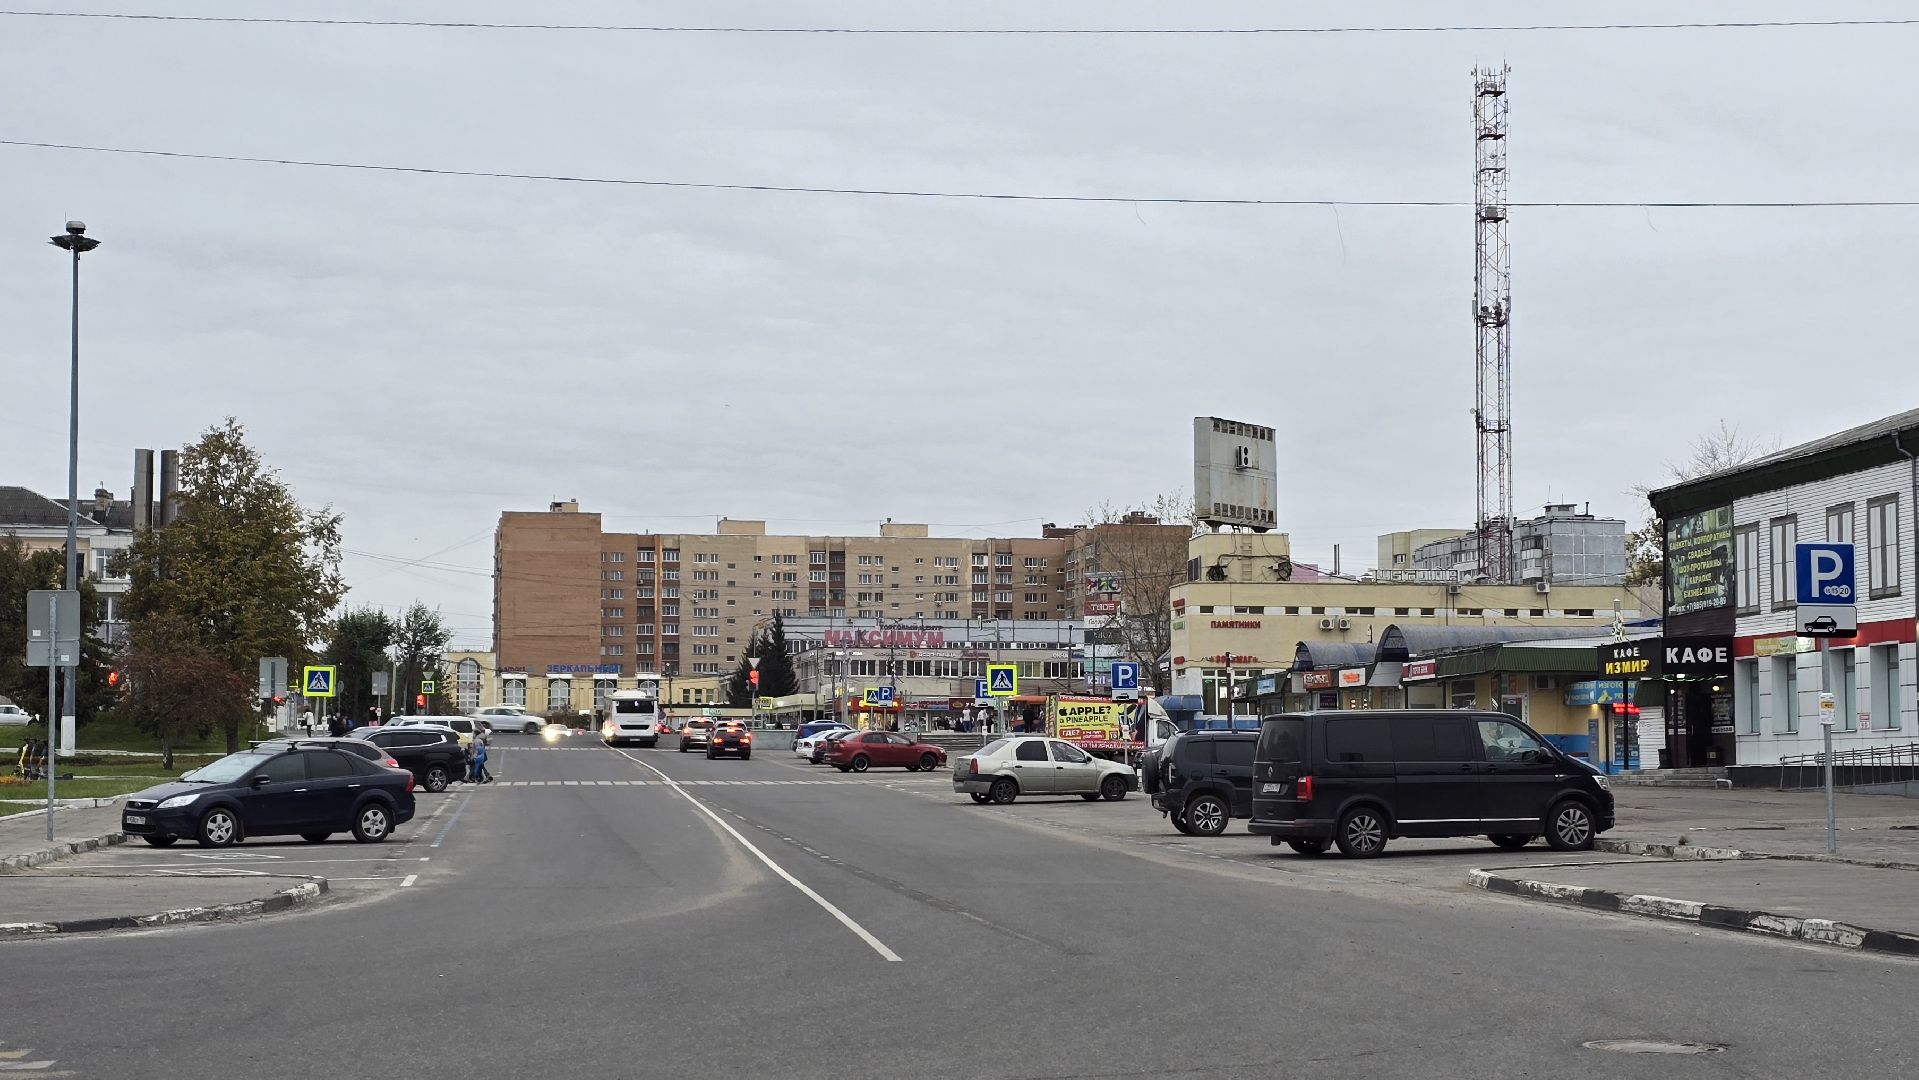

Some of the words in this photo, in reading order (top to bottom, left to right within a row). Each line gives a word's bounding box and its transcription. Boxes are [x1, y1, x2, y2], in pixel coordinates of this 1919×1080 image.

[1693, 529, 1730, 546] КОРПОРАТИВЫ
[1687, 547, 1712, 560] СВАДЬБЫ
[1679, 558, 1722, 573] ШОУ-ПРОГРАММЫ
[1689, 573, 1711, 584] КАРАОКЕ
[1810, 550, 1843, 597] P
[1683, 585, 1717, 598] БИЗНЕС-ЛАНЧ
[1840, 587, 1849, 595] 20
[1210, 620, 1261, 629] ПАМЯТНИКИ
[824, 629, 944, 648] МАКСИМУМ
[1613, 647, 1640, 659] КАФЕ
[1665, 647, 1728, 663] КАФЕ
[546, 663, 623, 673] ЗЕРКАЛЬНЫЙ
[1605, 659, 1649, 675] ИЗМИР
[1118, 665, 1133, 687] P
[881, 687, 890, 699] P
[1069, 706, 1111, 716] APPLE?
[1066, 715, 1109, 724] PINEAPPLE
[1062, 729, 1080, 737] ГДЕ?
